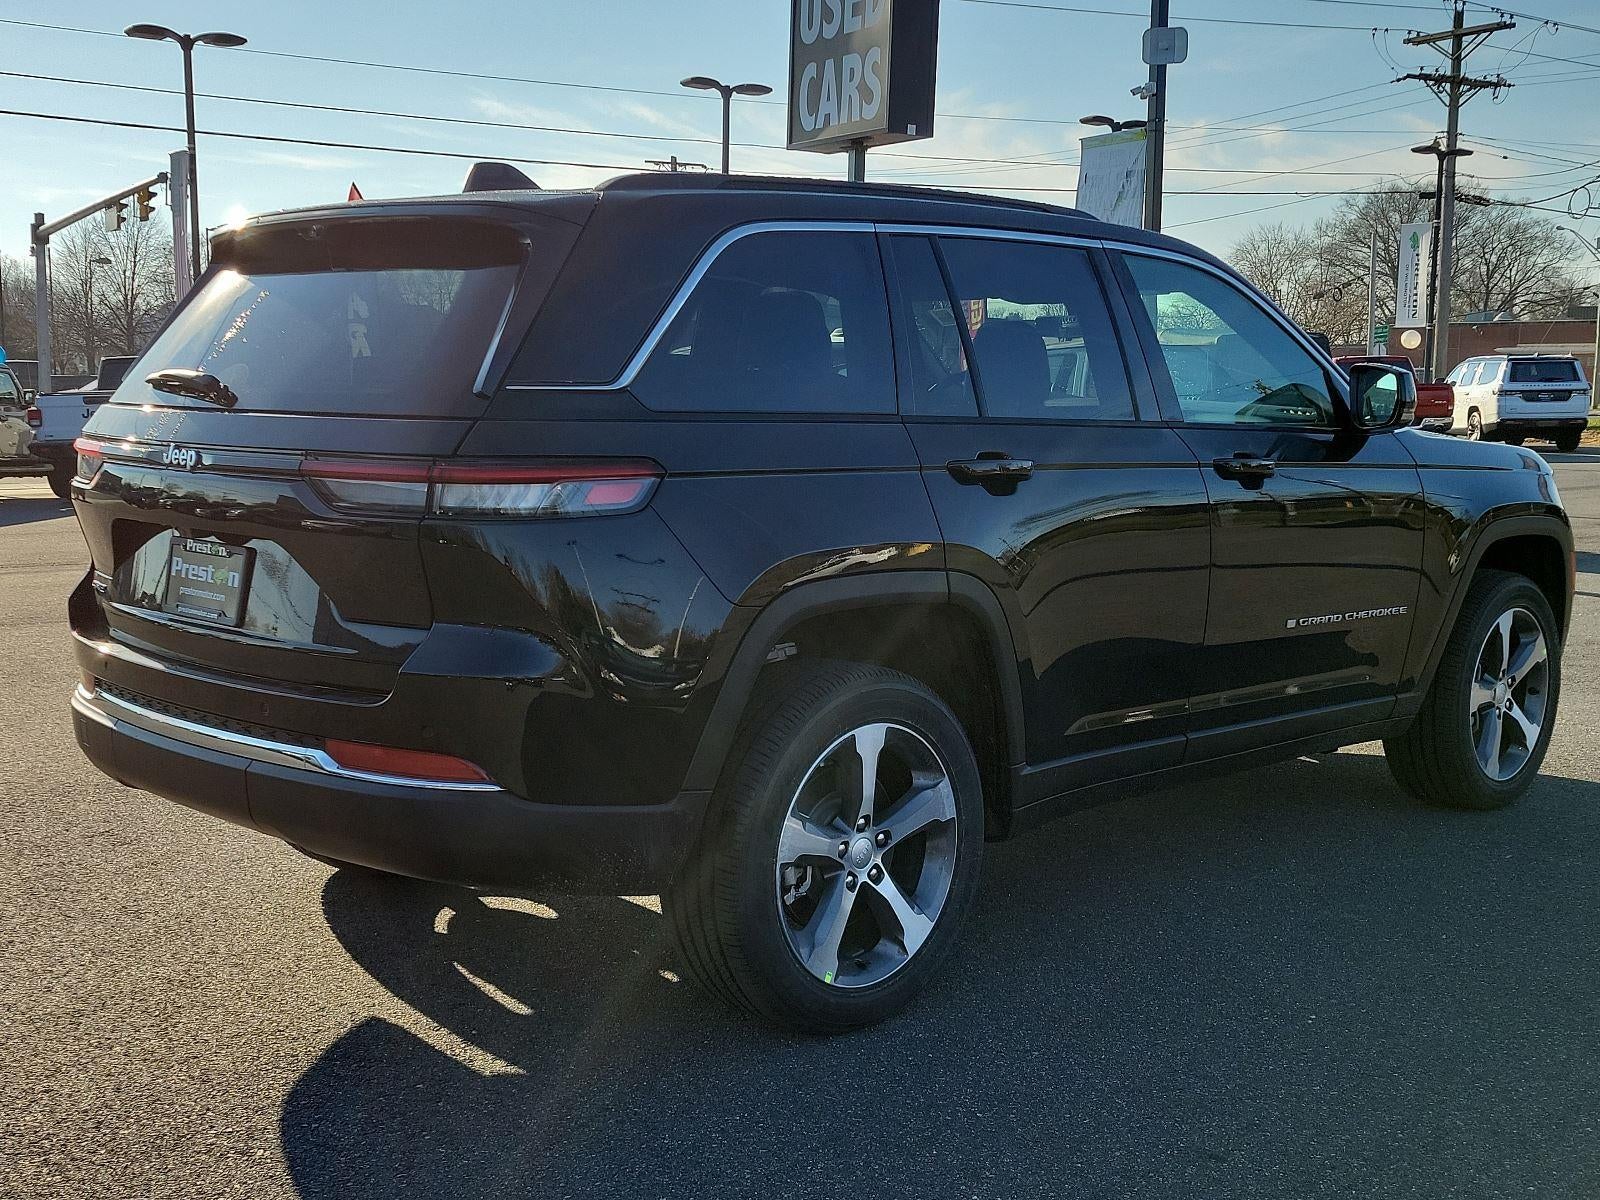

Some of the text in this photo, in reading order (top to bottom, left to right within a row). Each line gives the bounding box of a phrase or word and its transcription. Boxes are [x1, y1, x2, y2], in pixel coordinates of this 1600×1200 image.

[799, 46, 881, 132] CARS
[162, 442, 196, 471] Jeep
[171, 556, 239, 588] Preston
[1299, 606, 1408, 626] GRAND CHEROKEE
